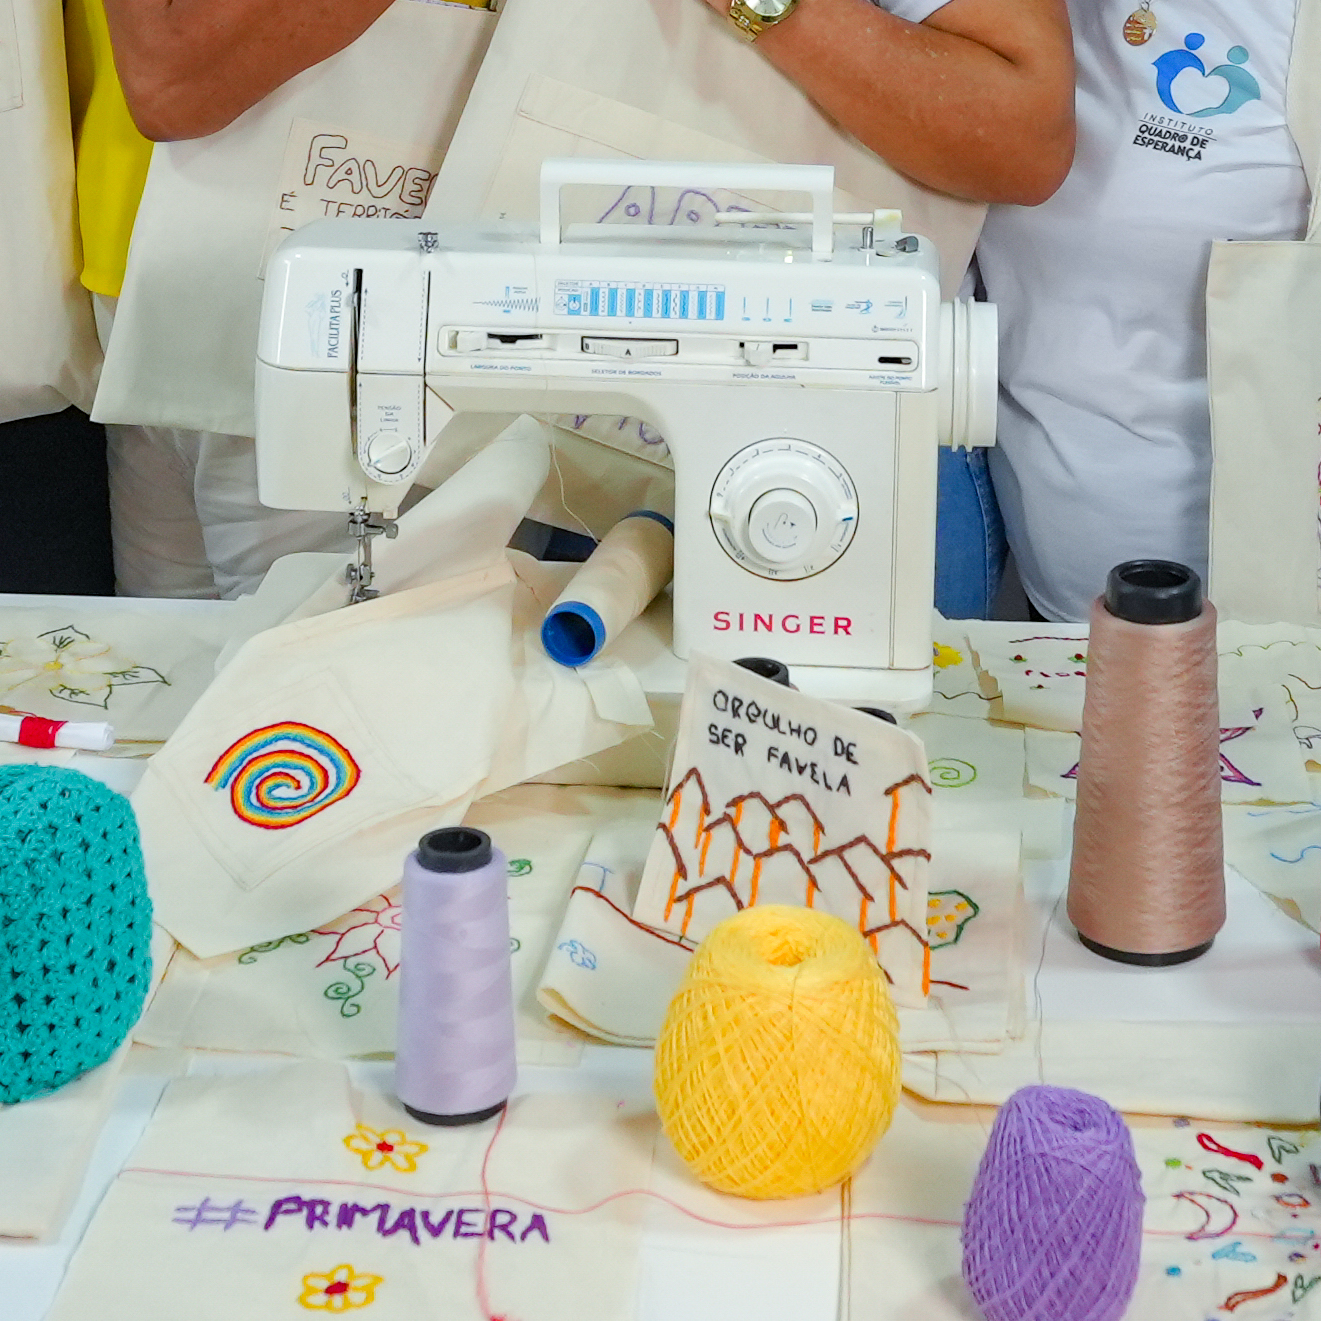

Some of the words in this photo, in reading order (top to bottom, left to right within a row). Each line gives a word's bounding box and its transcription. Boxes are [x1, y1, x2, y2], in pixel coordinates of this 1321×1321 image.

[1138, 123, 1189, 144] QUADRO
[1190, 135, 1210, 150] DE
[1143, 112, 1214, 136] INSTITUTO
[1132, 134, 1203, 162] ESPERANÇA
[279, 190, 298, 212] É
[329, 289, 343, 313] PLUS
[327, 314, 341, 359] FACILITA
[713, 610, 853, 636] SINGER
[712, 689, 818, 746] ORGULHO
[833, 735, 859, 765] DE
[708, 723, 748, 757] SER
[767, 746, 852, 797] FAVELA
[171, 1193, 551, 1246] #PRIMAVERA
